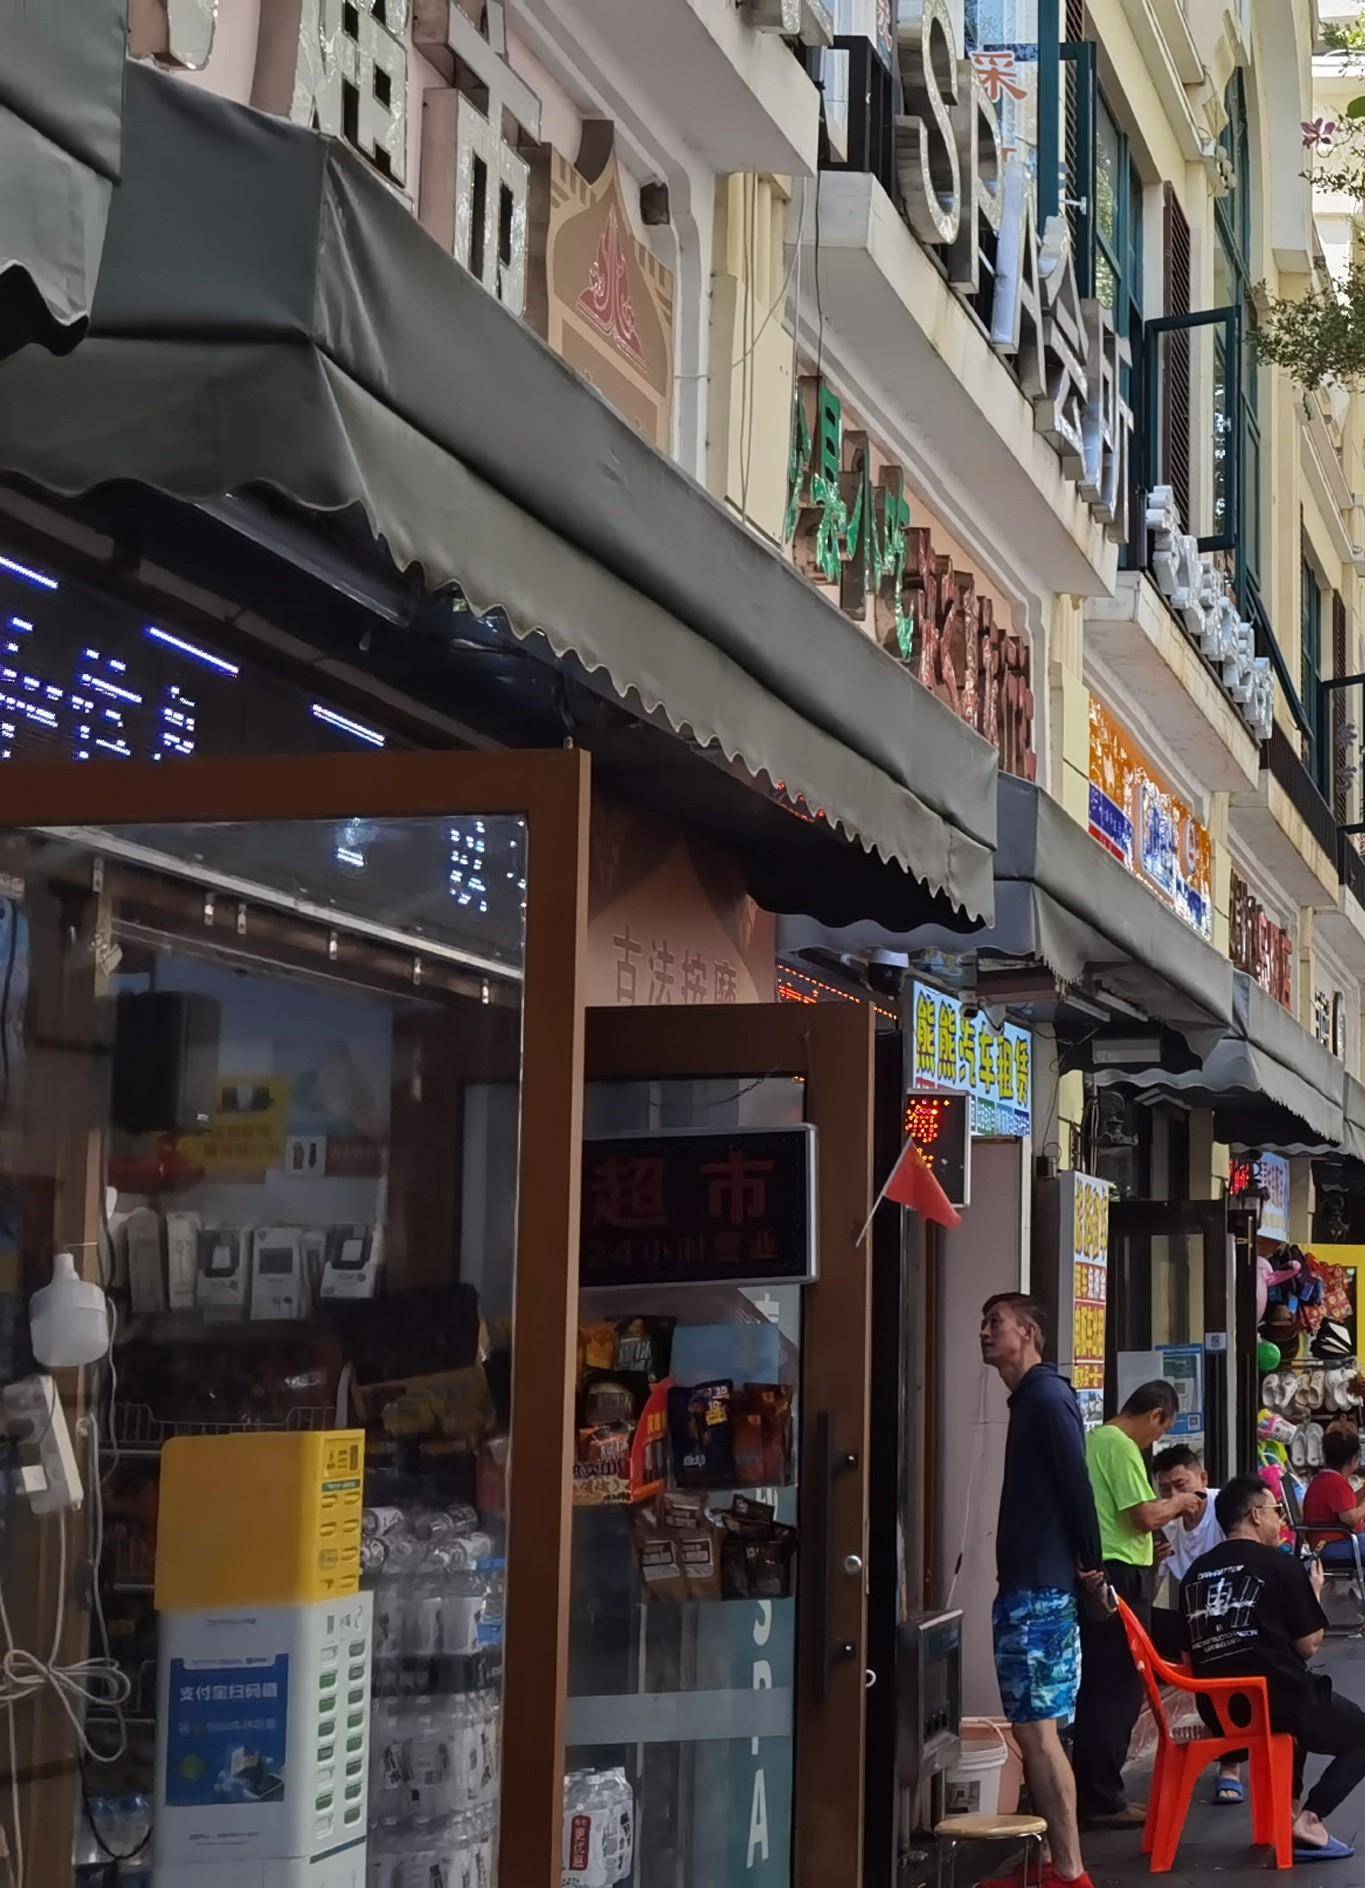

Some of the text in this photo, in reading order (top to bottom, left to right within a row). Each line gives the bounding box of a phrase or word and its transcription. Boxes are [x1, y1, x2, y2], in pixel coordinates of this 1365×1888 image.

[915, 988, 1032, 1110] 熊熊汽车租赁
[591, 1144, 777, 1229] 超市
